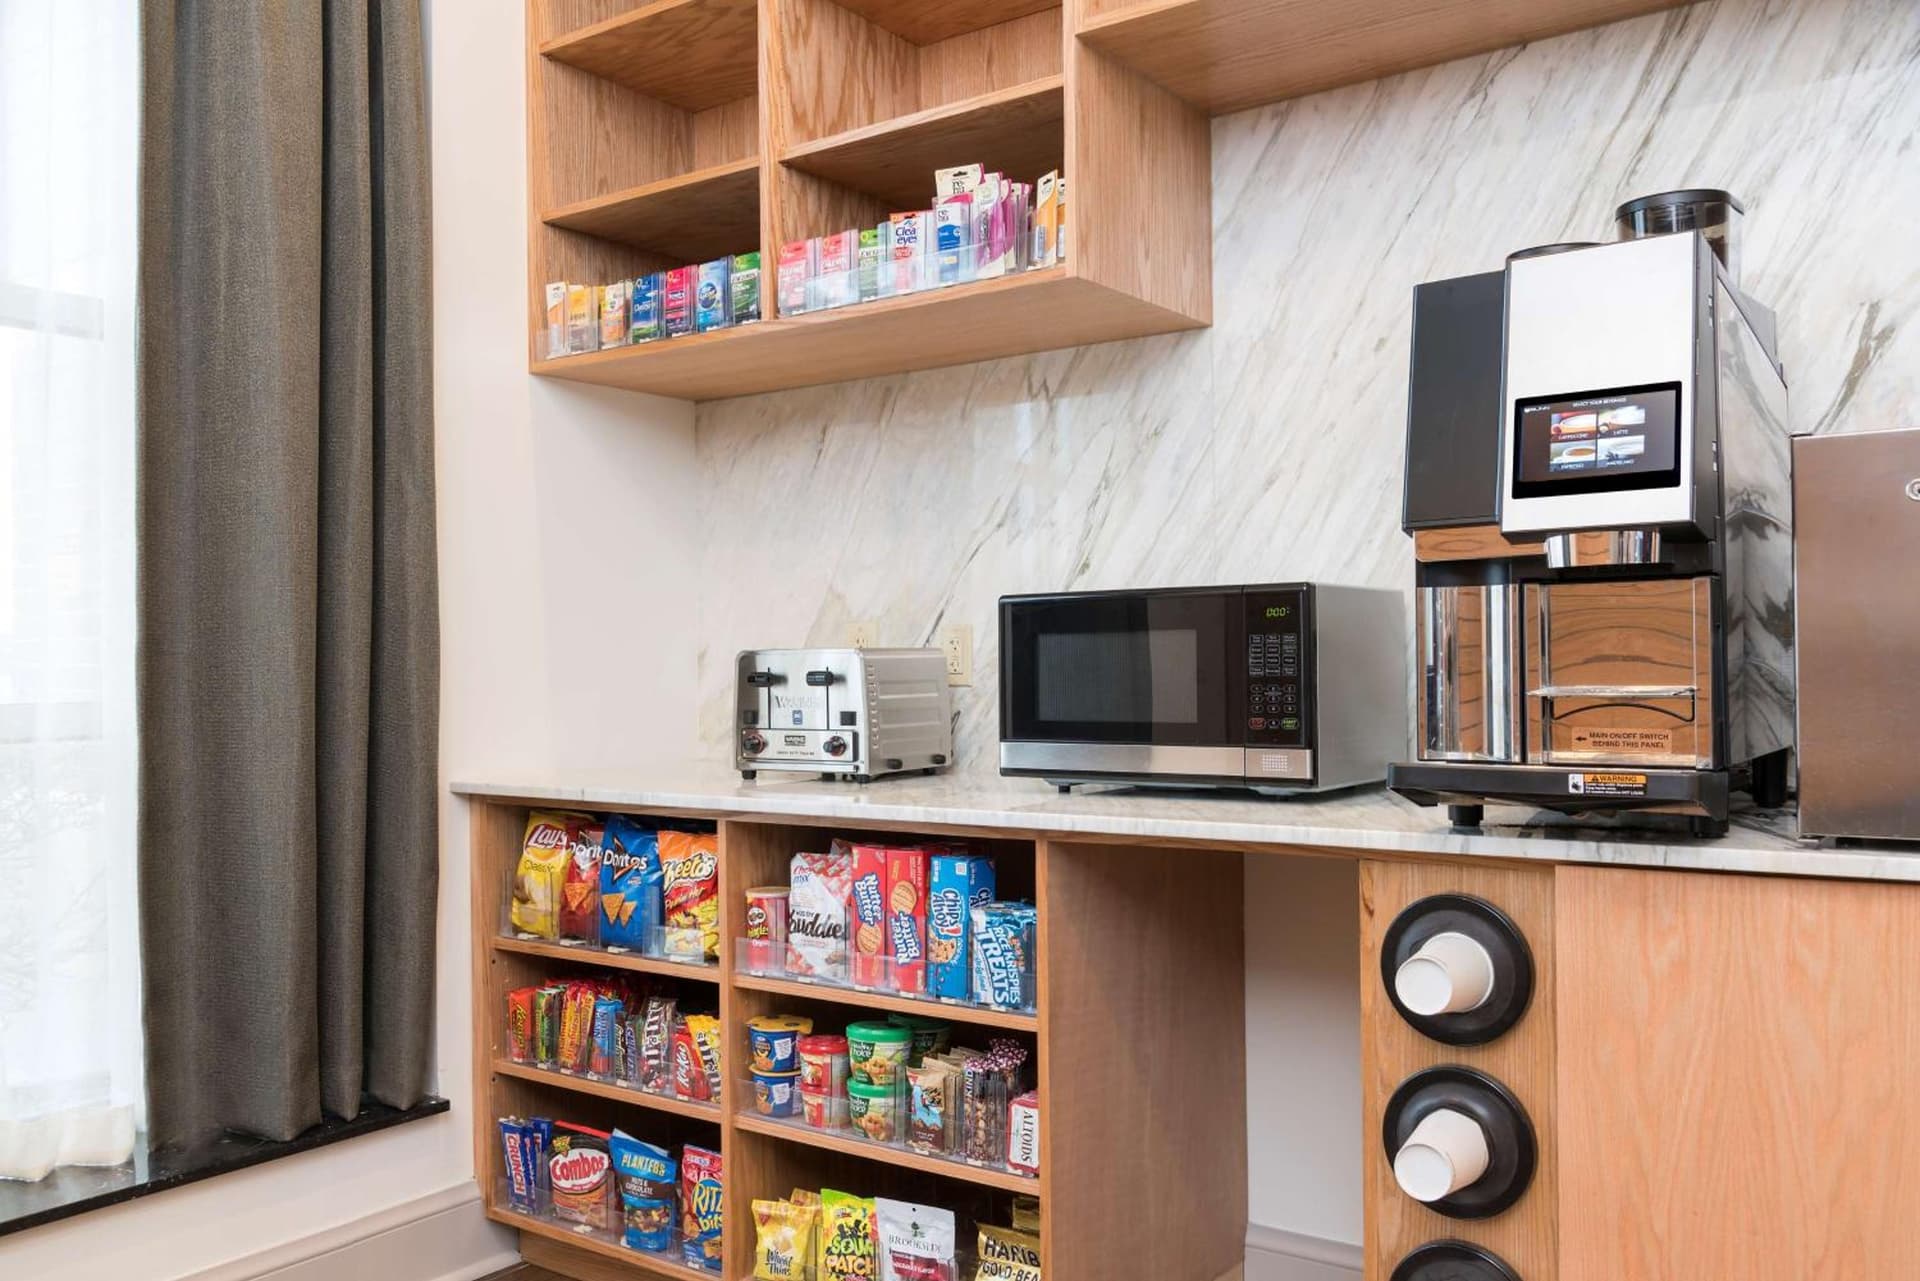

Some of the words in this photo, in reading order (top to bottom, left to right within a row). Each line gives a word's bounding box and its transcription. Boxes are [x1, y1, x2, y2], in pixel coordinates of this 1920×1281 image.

[1639, 733, 1670, 741] SWITCH
[603, 849, 648, 870] Doritos
[942, 889, 962, 927] Chips
[975, 927, 1009, 1004] TREATS
[992, 926, 1011, 952] RICE
[1003, 952, 1021, 1004] KRISPIES
[965, 1069, 975, 1099] KIND
[1021, 1111, 1035, 1162] ALTOIDS
[507, 1135, 525, 1193] CRUNCH
[552, 1152, 605, 1181] Combos
[622, 1152, 666, 1177] PLANTERS
[832, 1236, 874, 1257] SOUR
[826, 1255, 874, 1275] PATCH
